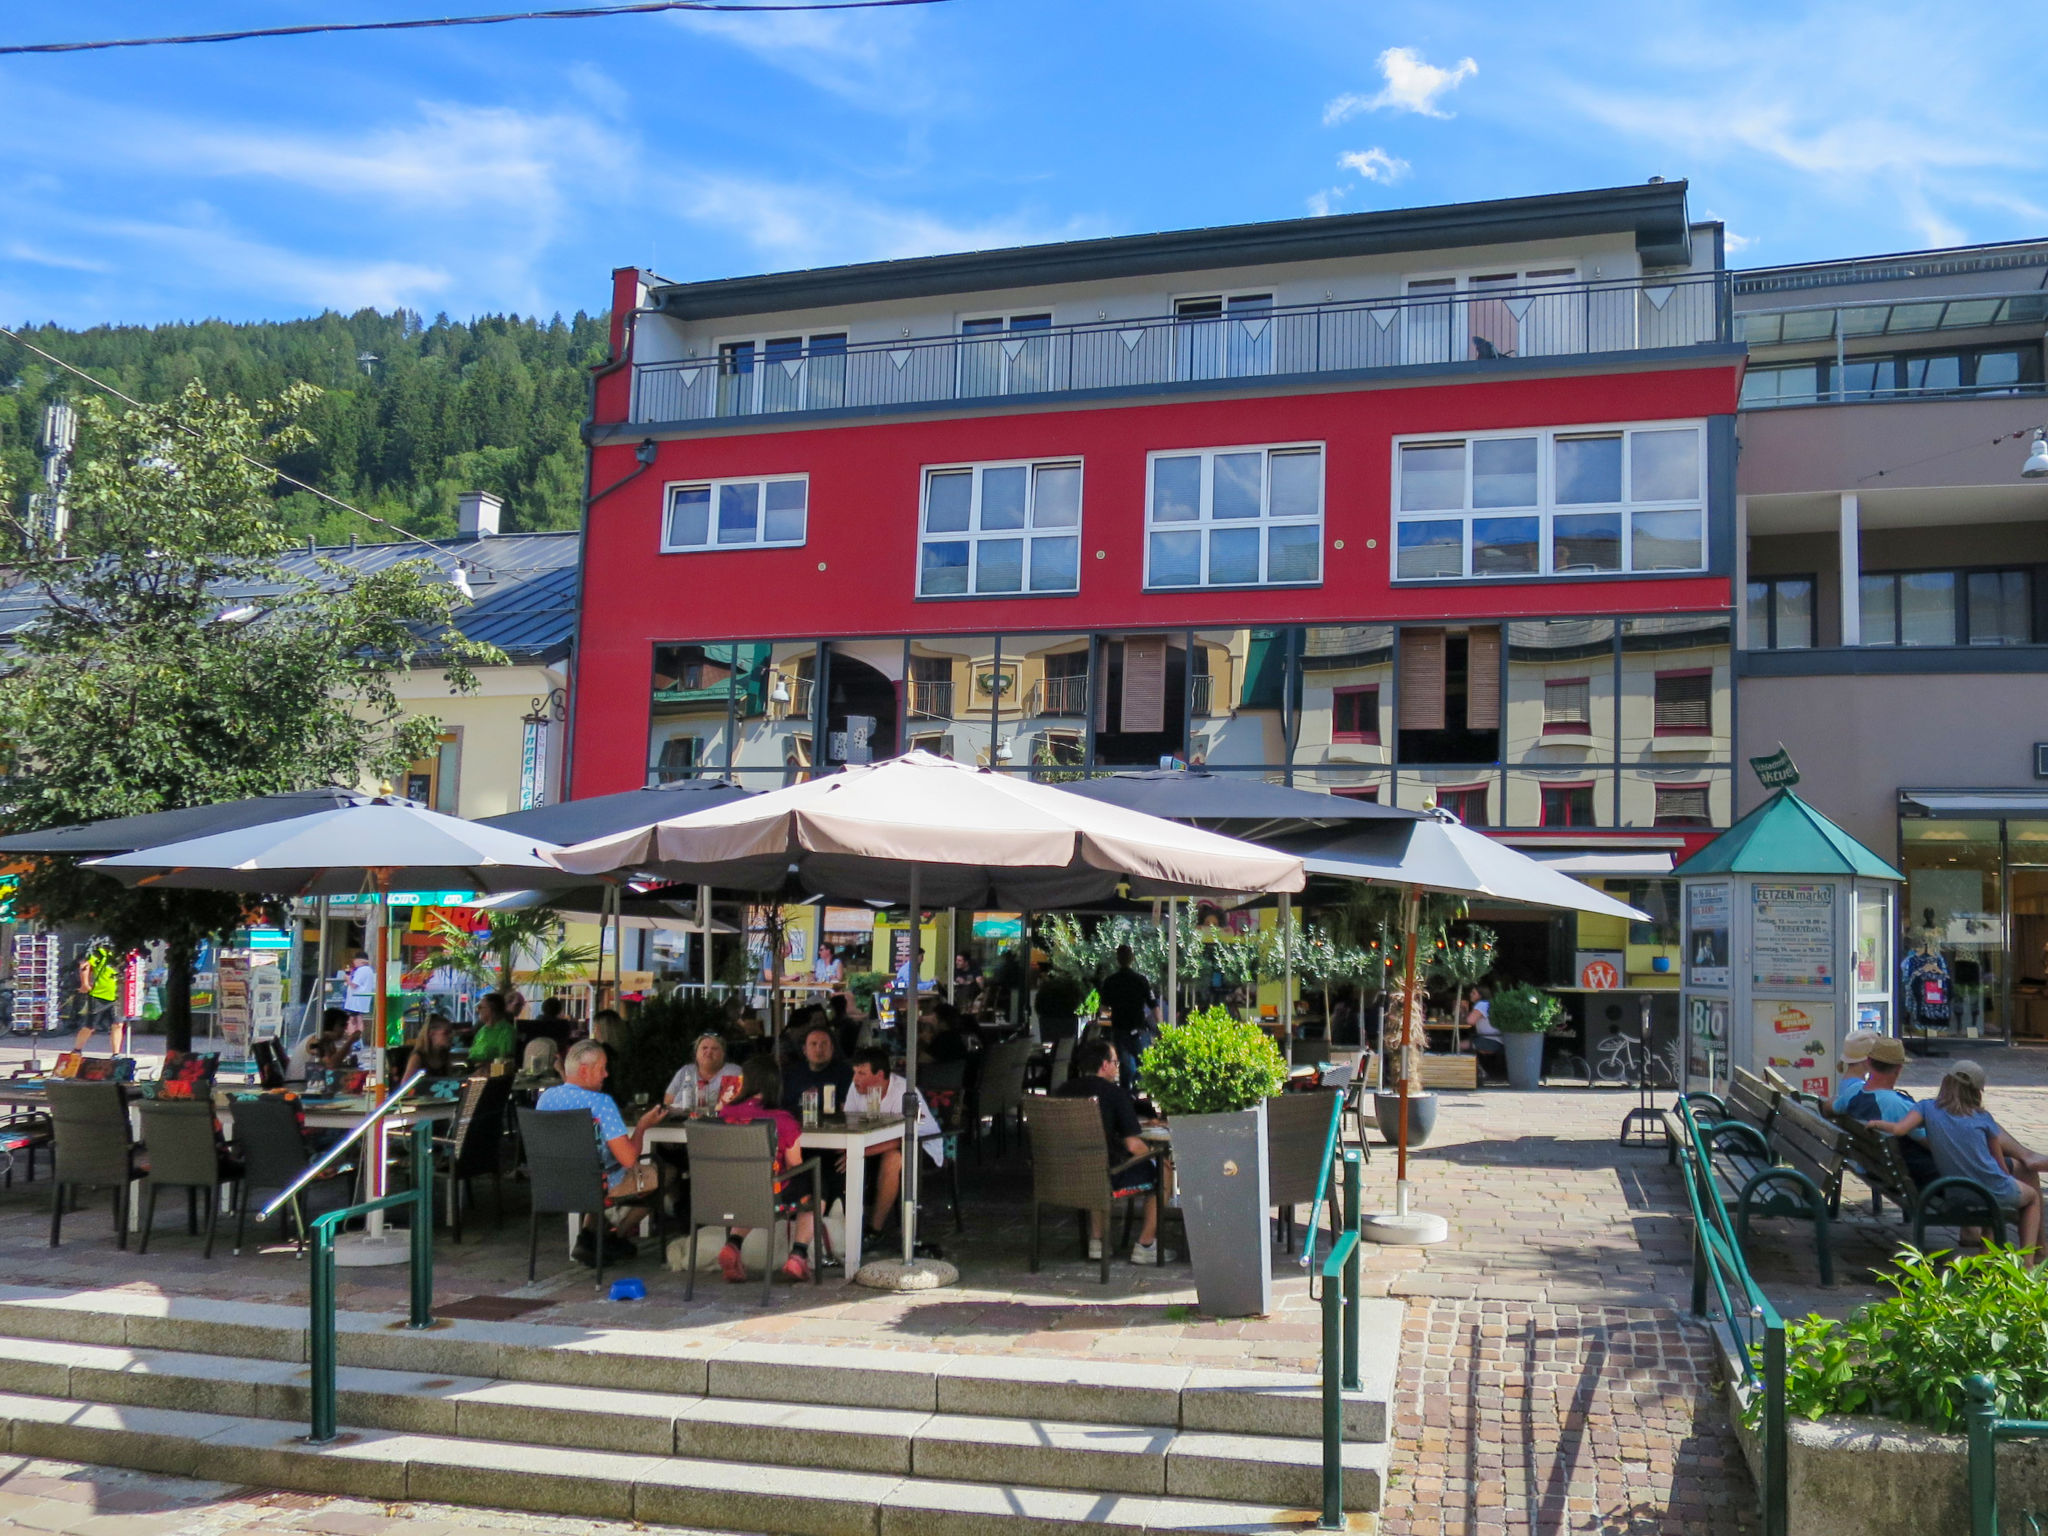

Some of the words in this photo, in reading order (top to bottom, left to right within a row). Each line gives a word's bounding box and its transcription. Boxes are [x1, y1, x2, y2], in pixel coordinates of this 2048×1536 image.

[328, 893, 358, 904] LOTTO
[387, 893, 420, 905] LOTTO
[1757, 889, 1795, 900] FETZEN
[1691, 1000, 1724, 1037] Bio
[1807, 1079, 1825, 1090] 2+1
